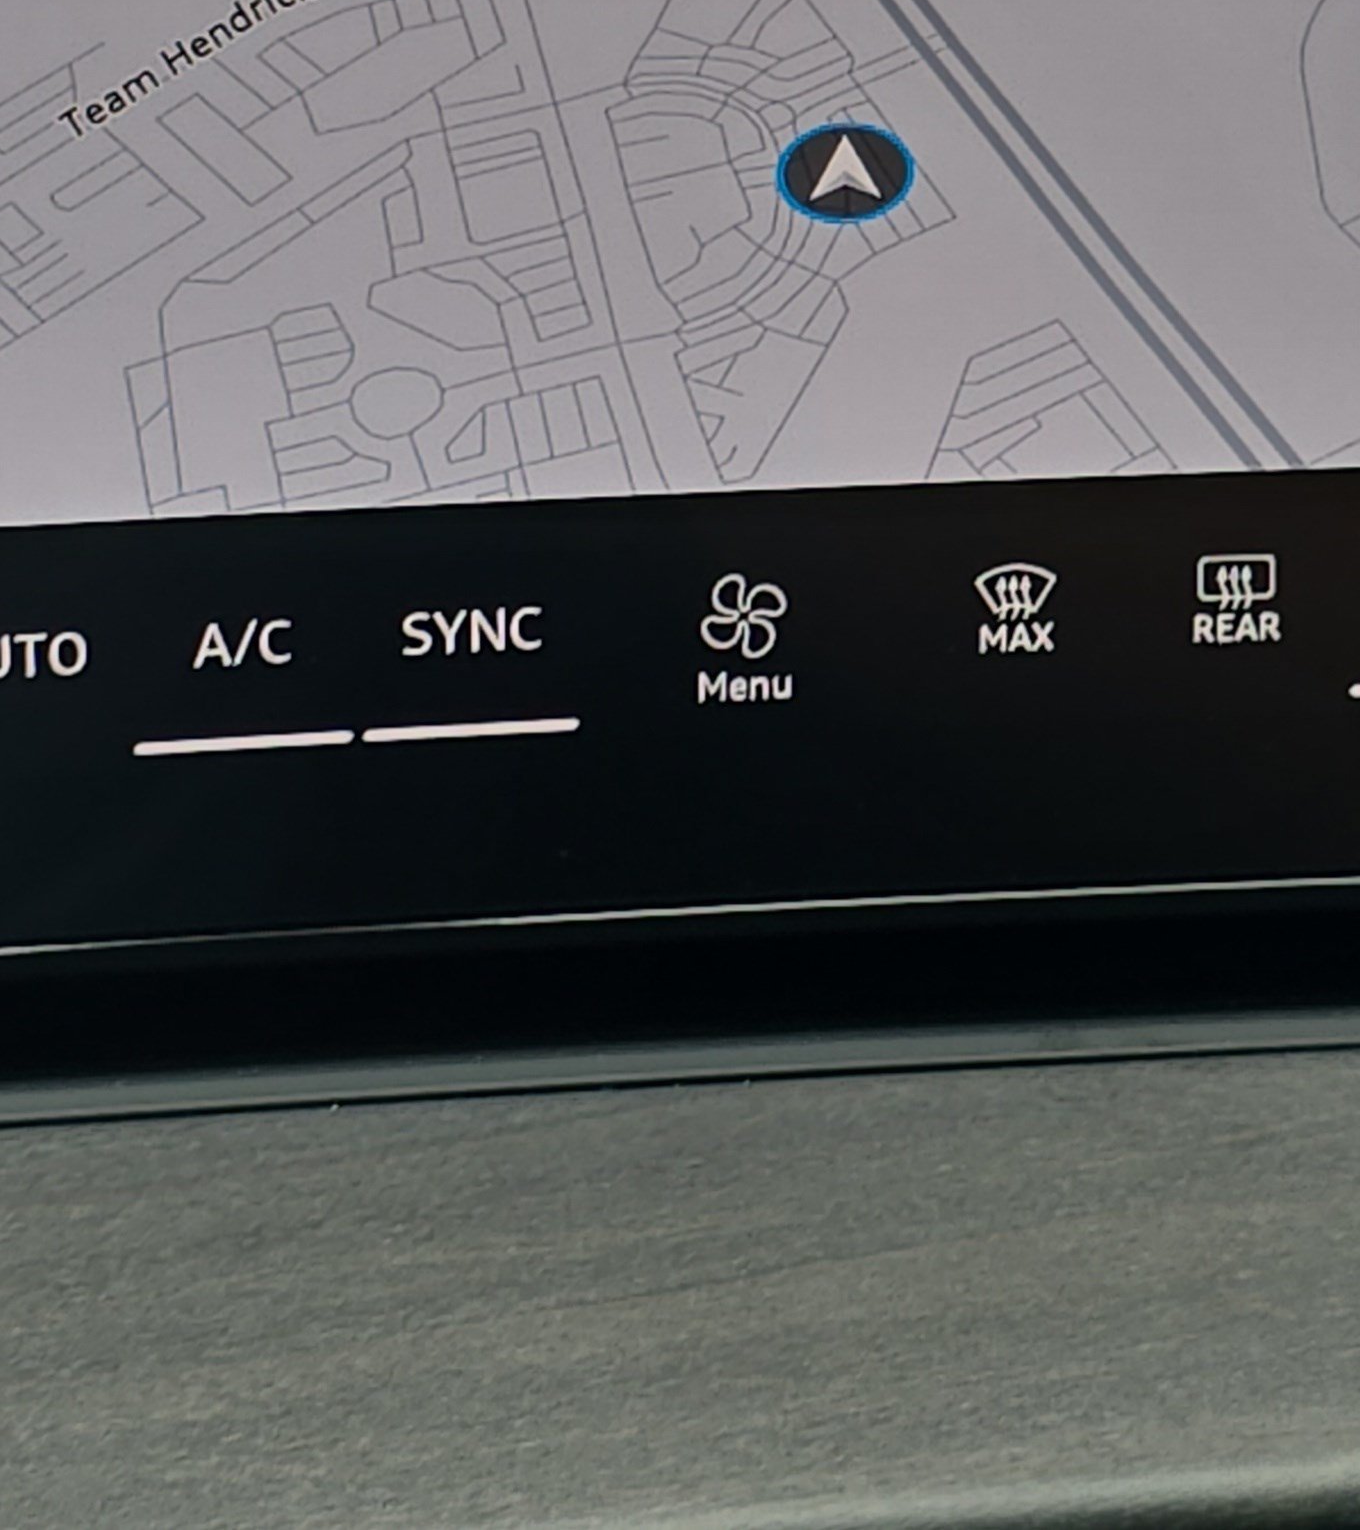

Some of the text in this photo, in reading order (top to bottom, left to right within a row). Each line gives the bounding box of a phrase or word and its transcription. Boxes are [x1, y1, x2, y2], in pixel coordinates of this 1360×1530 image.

[58, 74, 158, 138] Team
[192, 619, 293, 669] A/C
[401, 606, 544, 658] SYNC
[978, 622, 1055, 654] MAX
[1192, 612, 1281, 643] REAR
[697, 671, 793, 703] Menu
